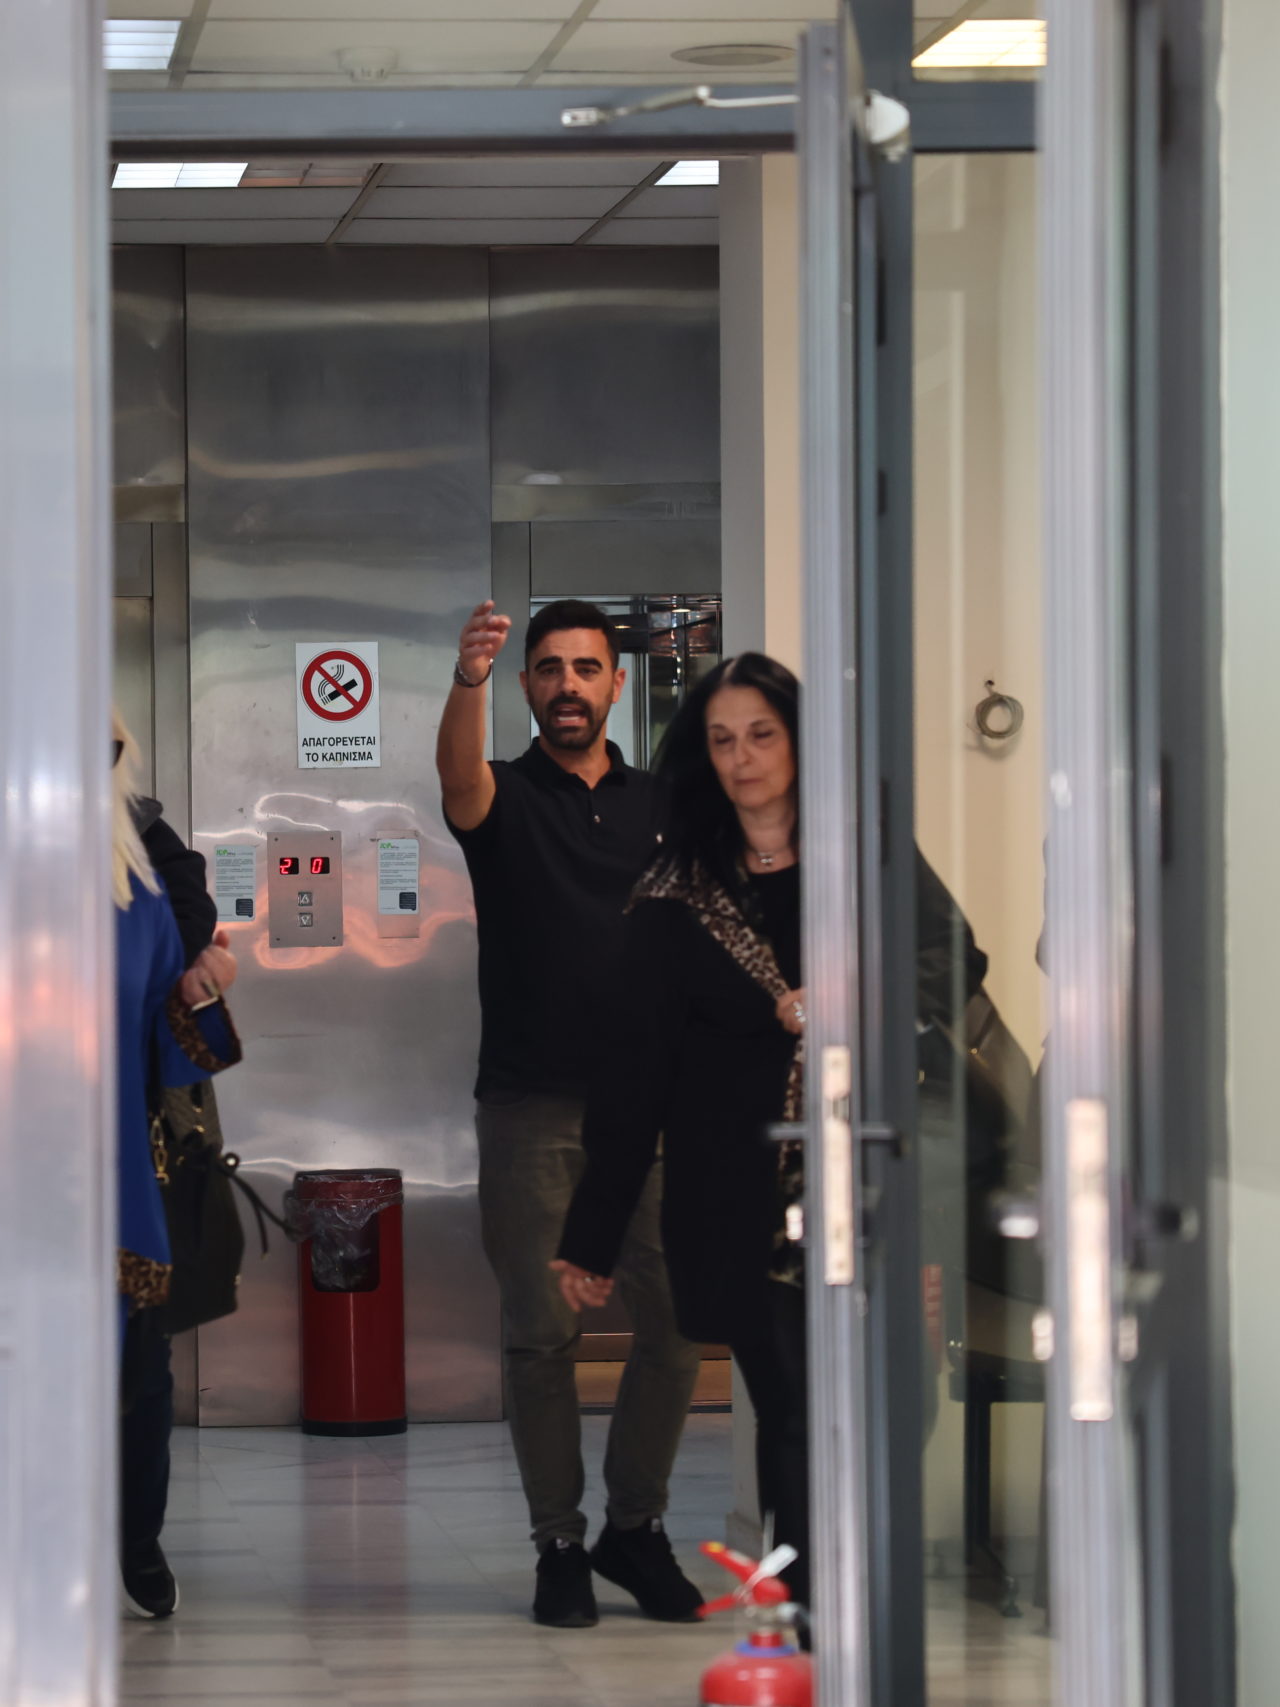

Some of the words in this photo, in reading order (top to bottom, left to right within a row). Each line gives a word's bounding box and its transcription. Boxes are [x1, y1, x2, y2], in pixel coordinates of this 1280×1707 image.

[302, 736, 376, 747] ΑΠΑΓΟΡΕΥΕΤΑΙ
[306, 752, 319, 762] ΤΟ
[322, 751, 373, 762] ΚΑΠΝΙΣΜΑ
